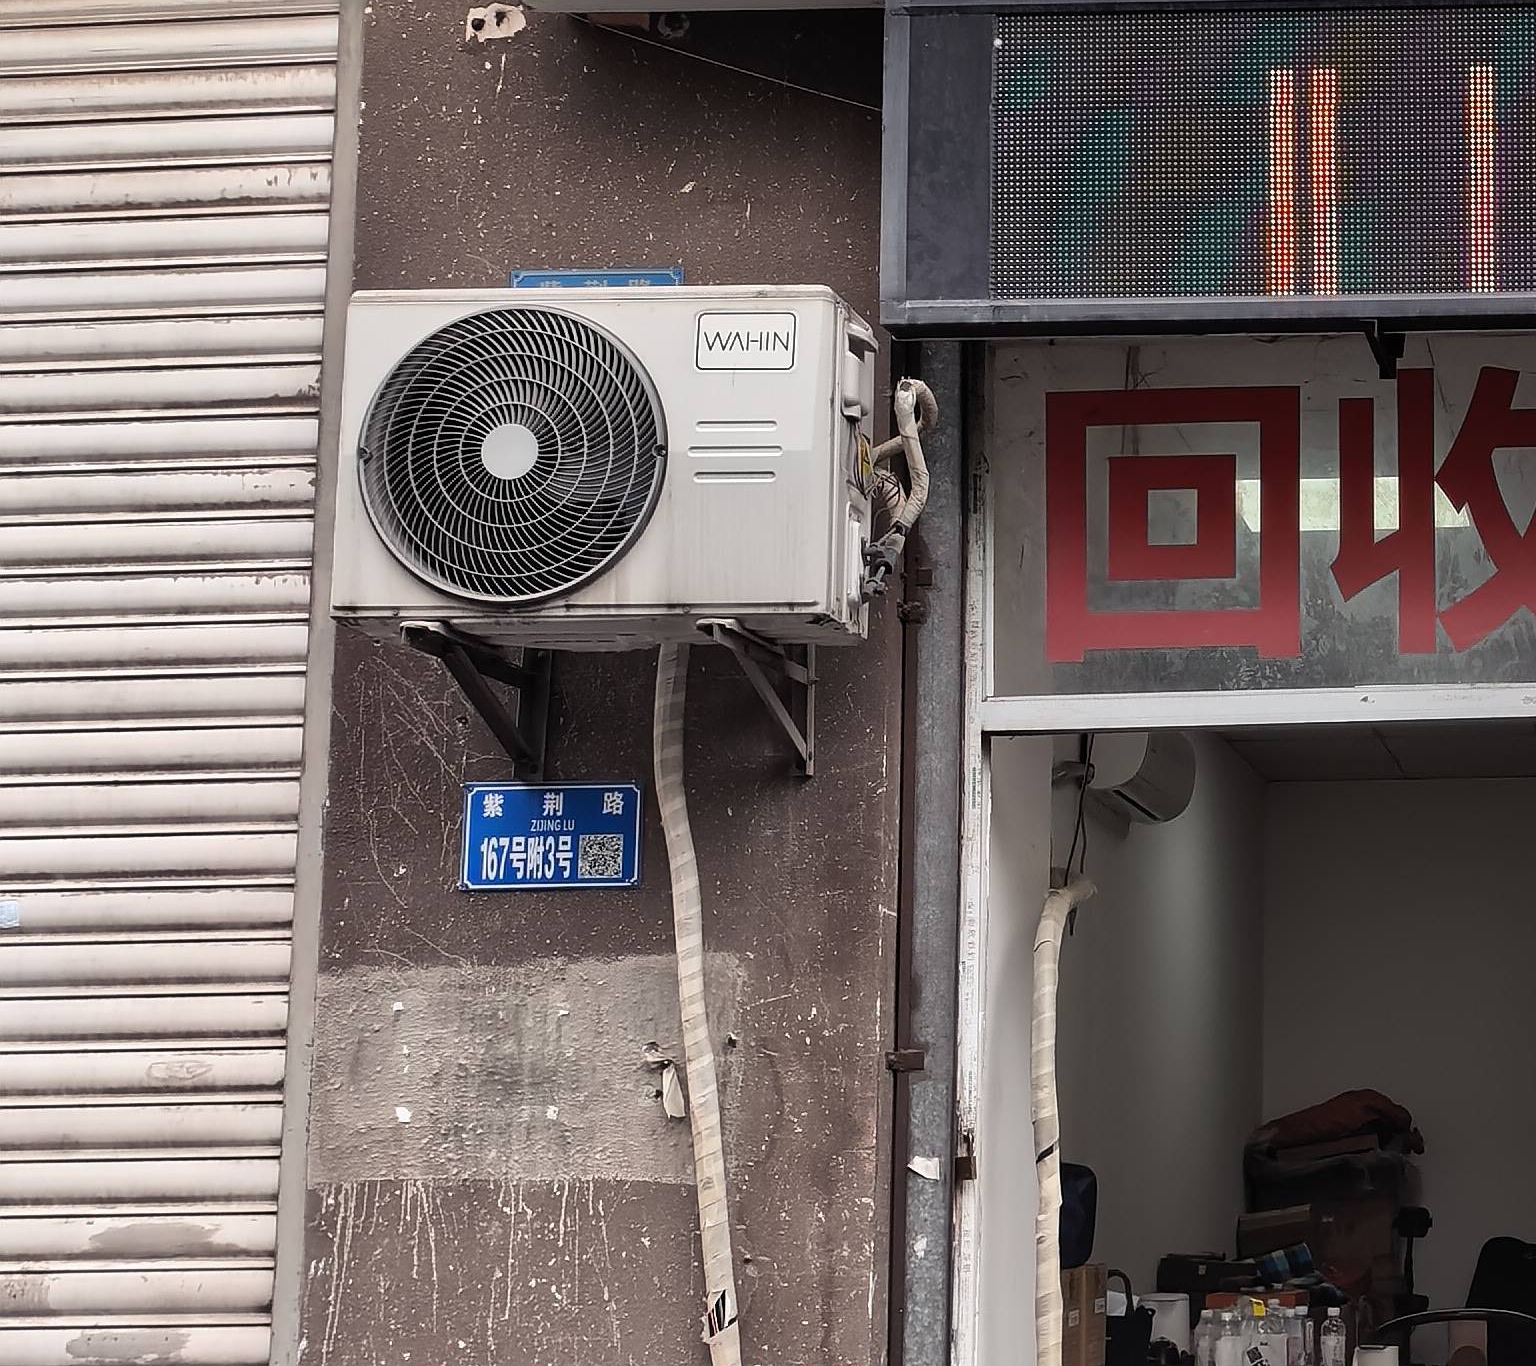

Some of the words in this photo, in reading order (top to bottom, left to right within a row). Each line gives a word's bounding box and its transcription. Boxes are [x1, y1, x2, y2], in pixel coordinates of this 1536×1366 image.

[704, 330, 789, 353] WAHIN
[483, 792, 624, 817] 紫荆路
[531, 820, 561, 832] ZIJING
[563, 819, 575, 831] LU
[480, 835, 573, 881] 167号附3号
